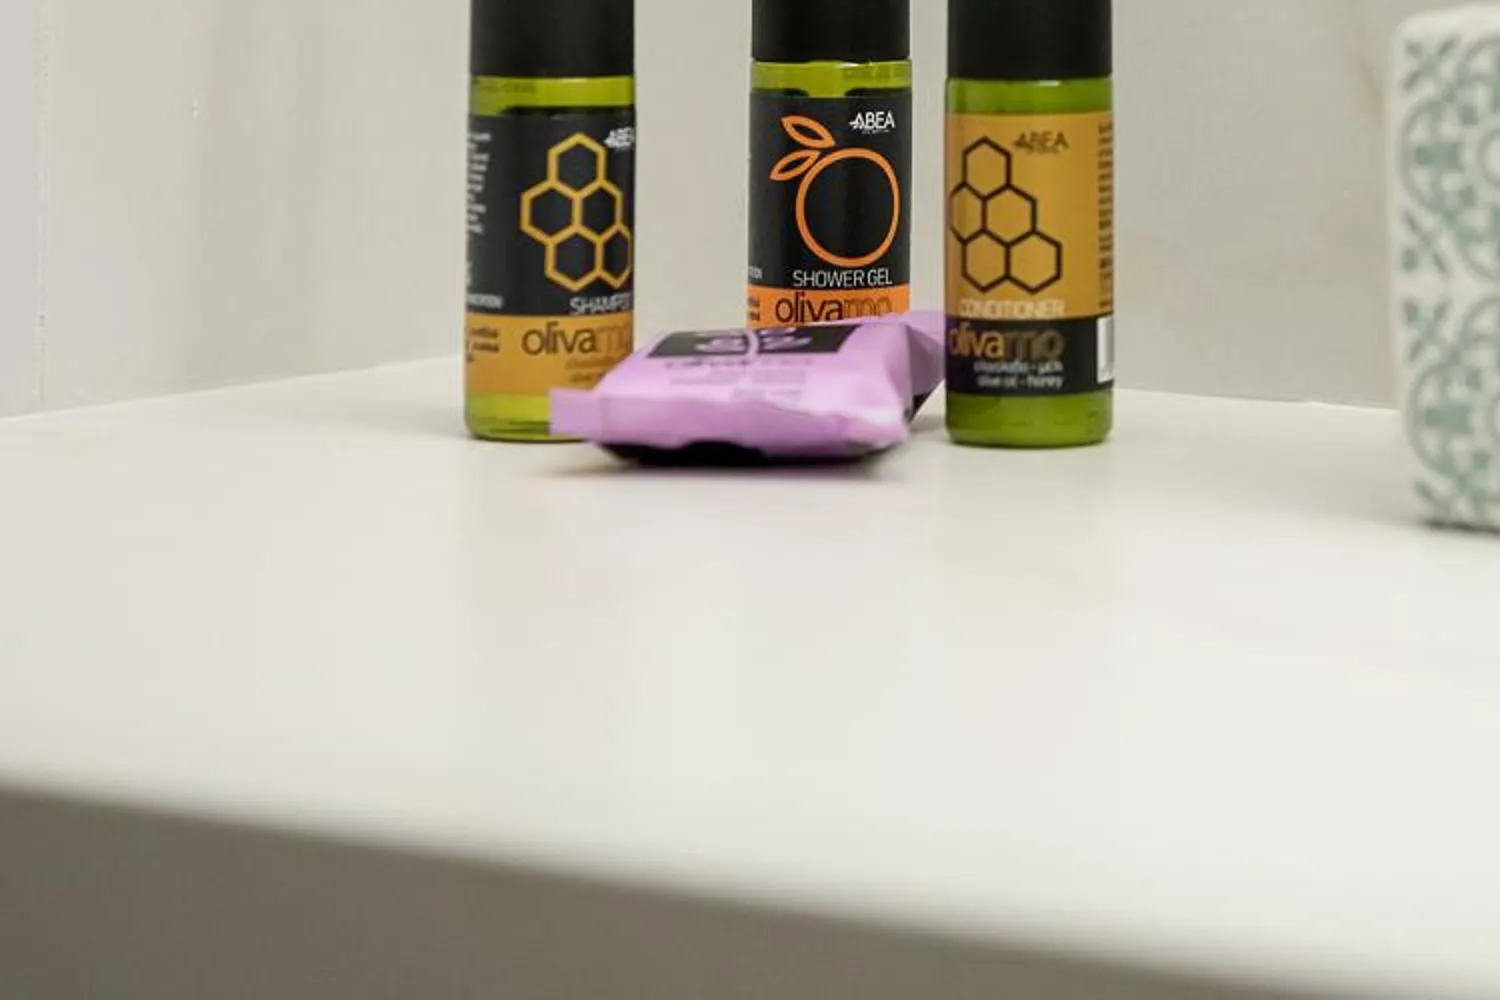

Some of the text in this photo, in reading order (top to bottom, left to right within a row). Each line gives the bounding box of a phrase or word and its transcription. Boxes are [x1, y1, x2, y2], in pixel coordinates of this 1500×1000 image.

[849, 110, 896, 129] ABEA
[793, 267, 892, 287] SHOWER GEL
